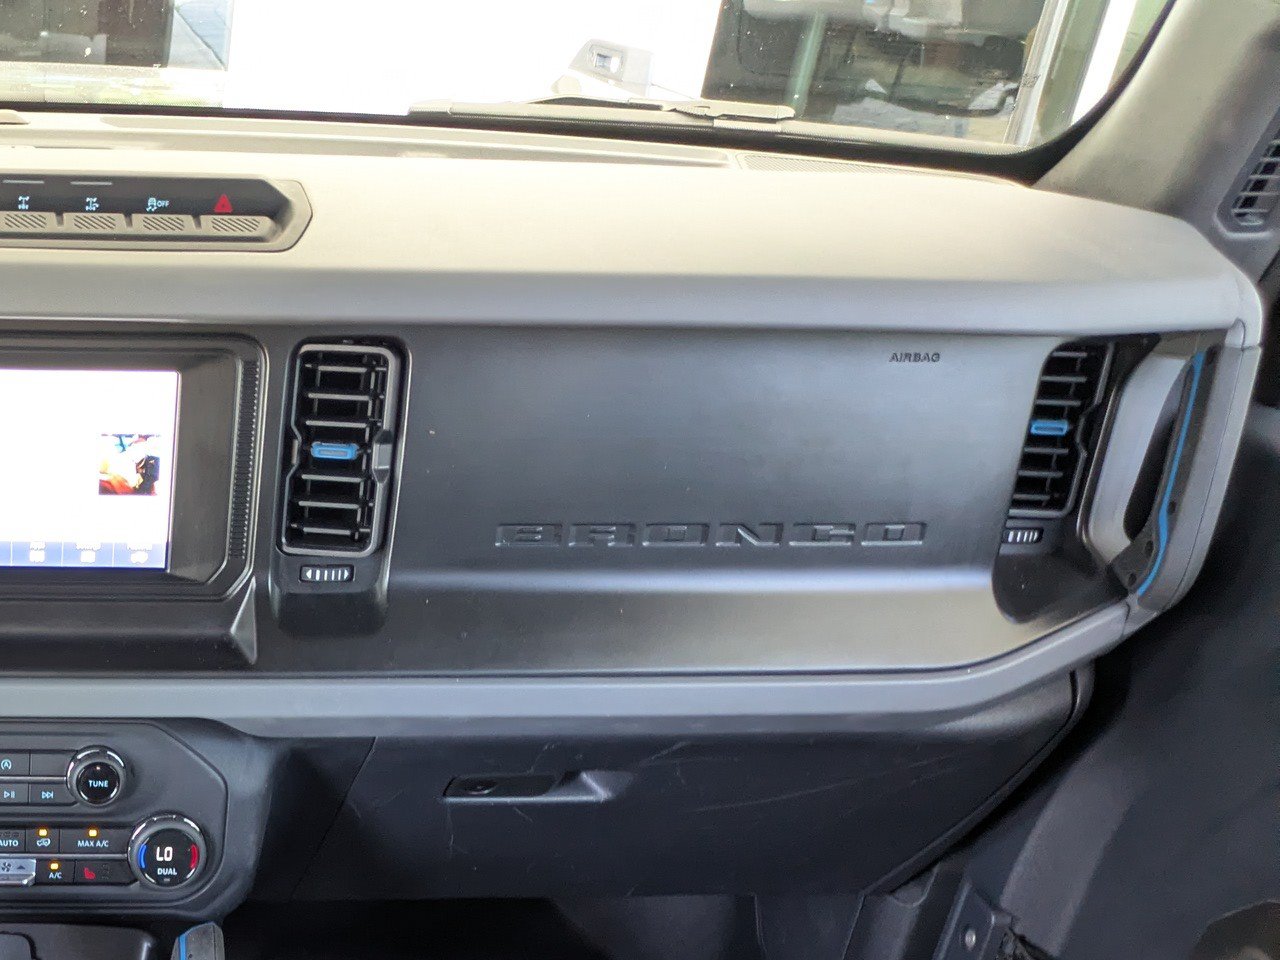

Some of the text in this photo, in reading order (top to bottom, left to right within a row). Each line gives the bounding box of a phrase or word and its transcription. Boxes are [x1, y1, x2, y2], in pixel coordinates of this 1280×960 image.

[157, 200, 170, 208] OFF
[888, 352, 941, 363] AIRBAG
[495, 523, 928, 548] BRONCO
[88, 780, 109, 788] TUNE
[77, 839, 109, 848] MAX A/C
[156, 846, 173, 862] LO
[48, 871, 63, 880] A/C
[157, 867, 178, 876] DUAL
